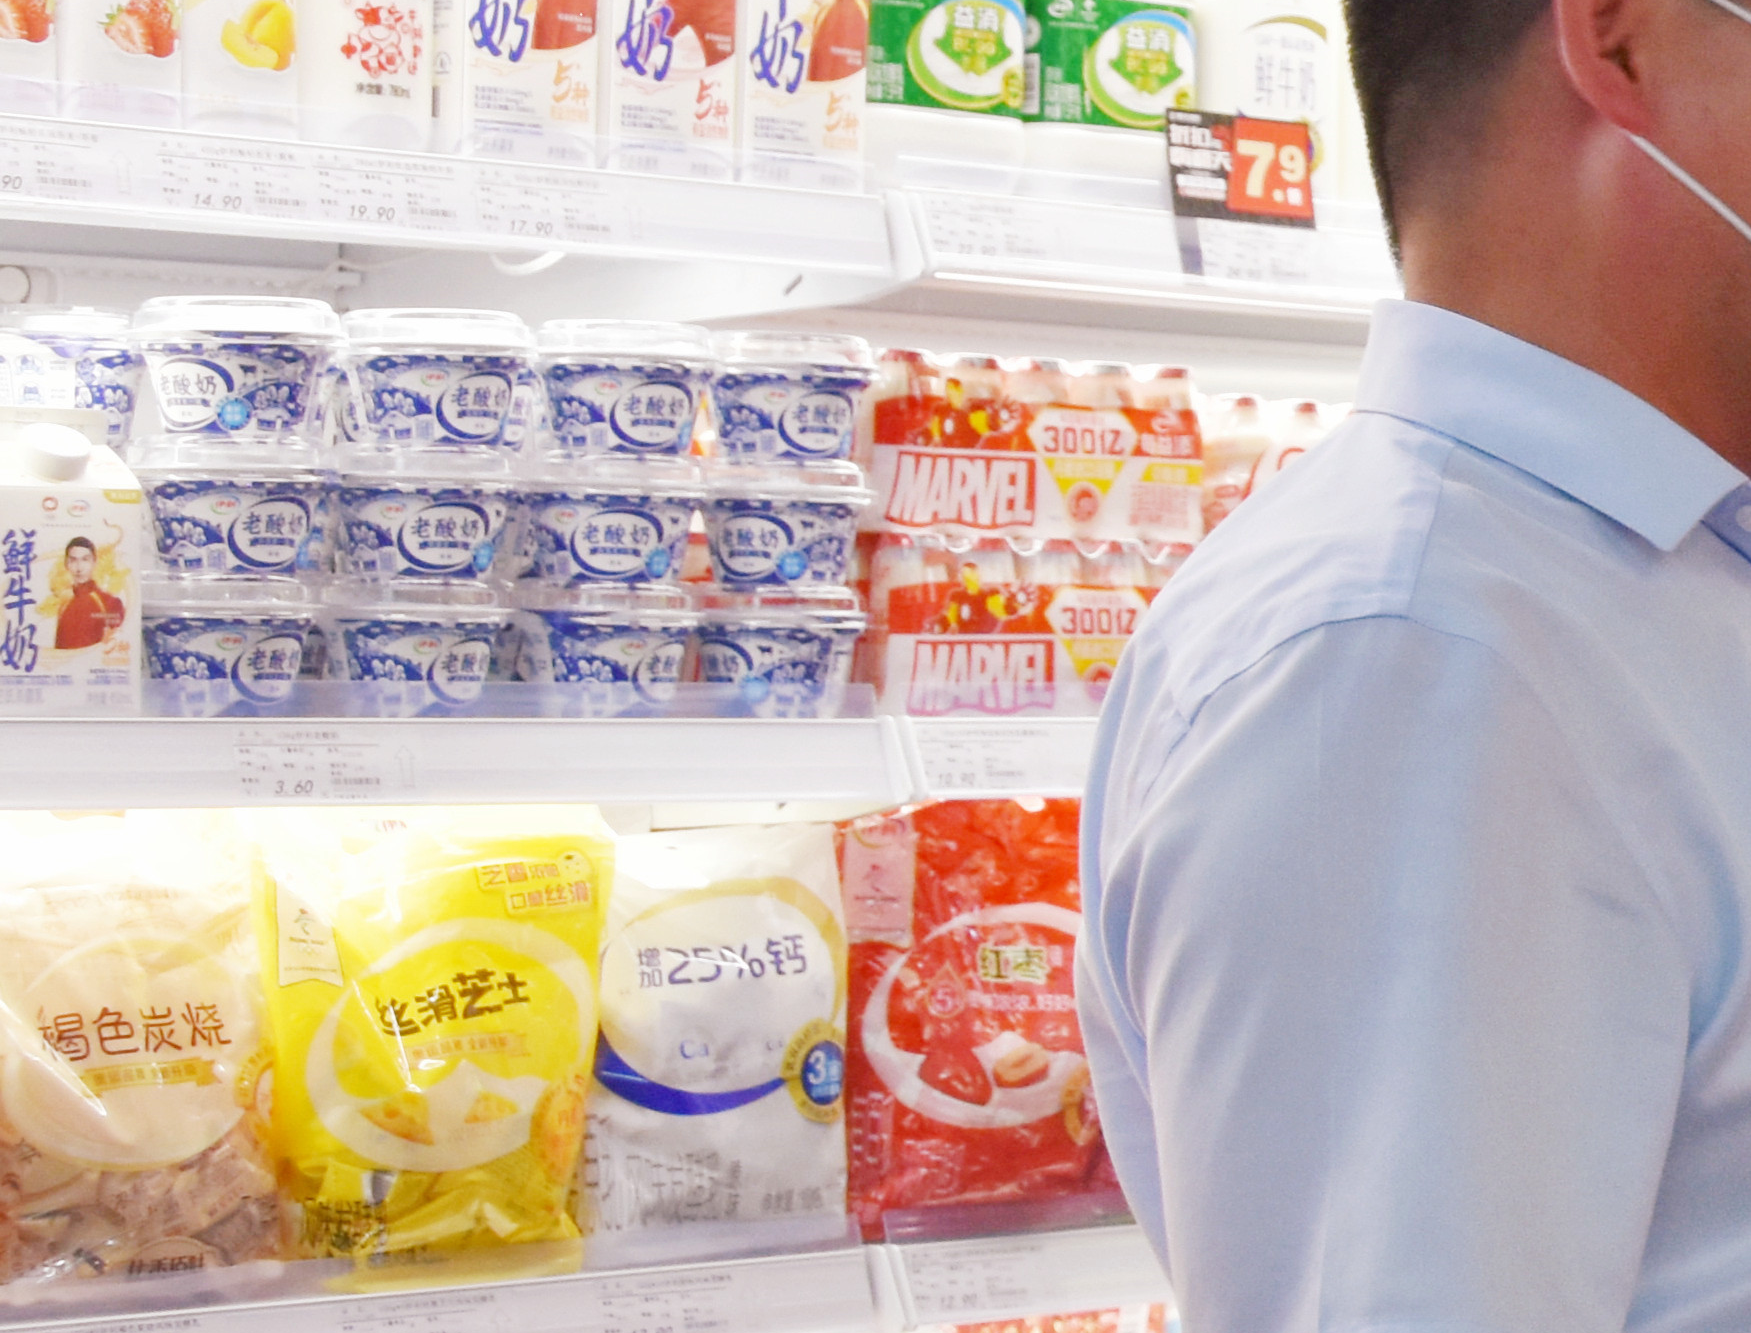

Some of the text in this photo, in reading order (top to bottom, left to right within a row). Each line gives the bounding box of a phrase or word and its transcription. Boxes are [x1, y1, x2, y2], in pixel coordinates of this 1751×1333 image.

[888, 453, 1037, 528] MARVEL
[412, 515, 481, 540] 老酸奶
[583, 521, 650, 546] 老酸奶
[0, 528, 38, 673] 鲜牛奶
[909, 641, 1055, 715] MARVEL
[665, 933, 808, 985] 25%钙
[37, 1002, 232, 1062] 褐色炭烧
[375, 968, 531, 1038] 丝滑芝士
